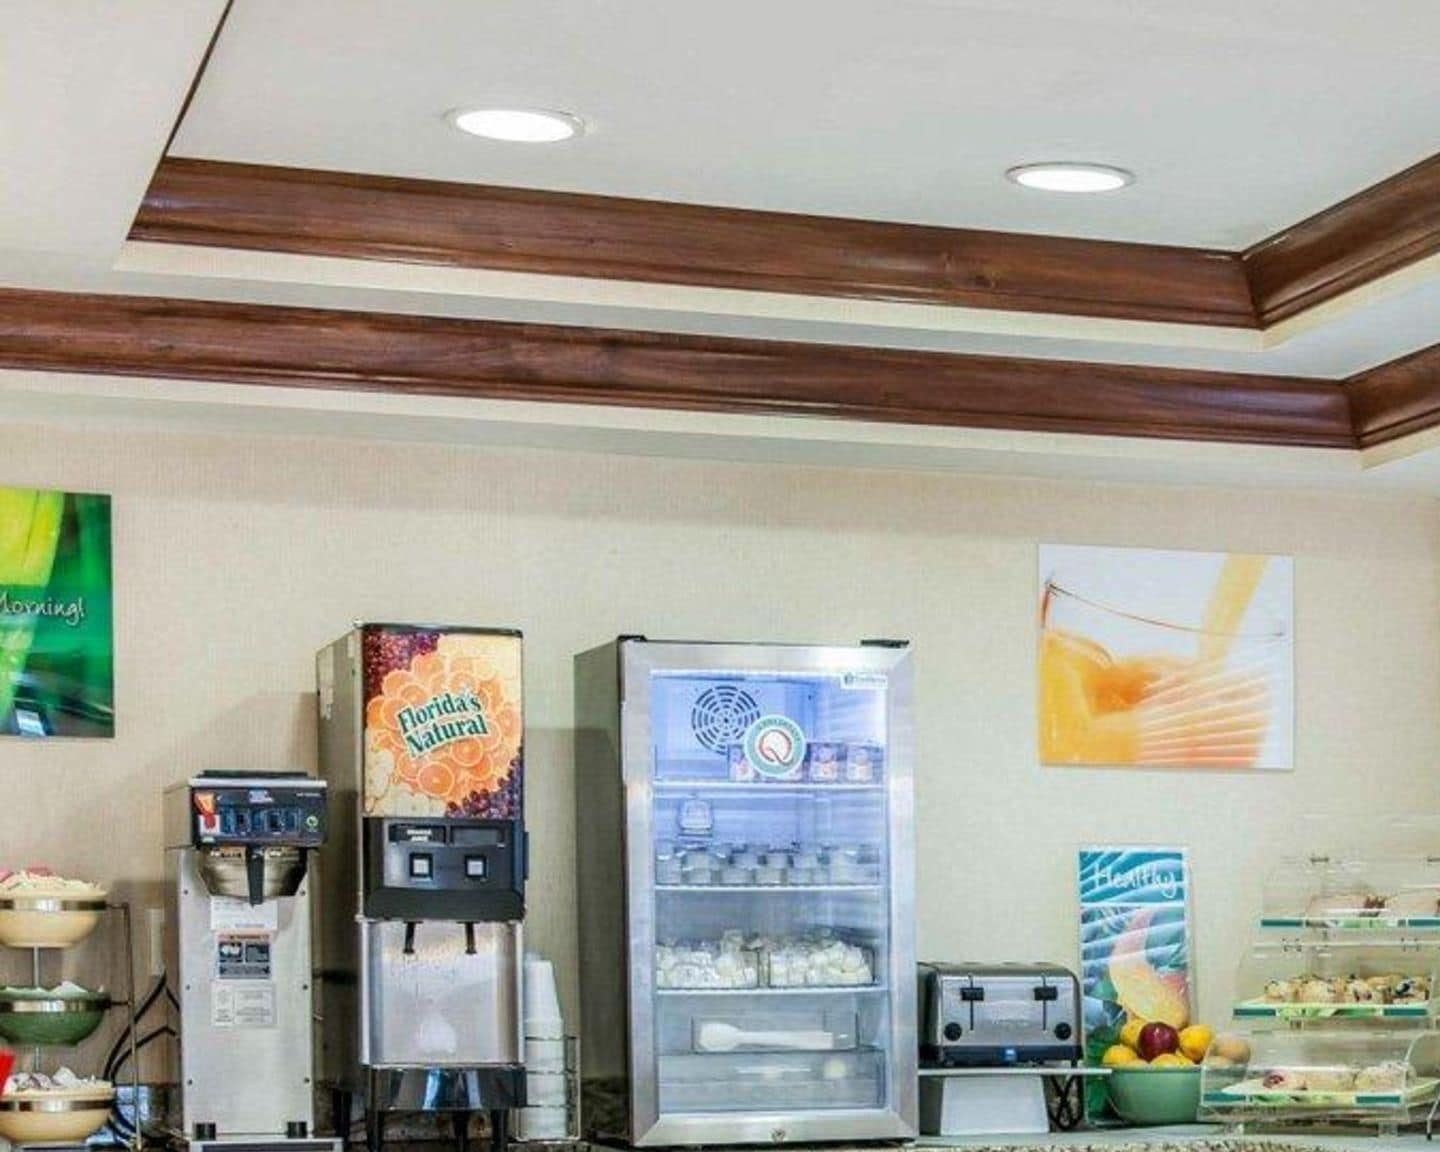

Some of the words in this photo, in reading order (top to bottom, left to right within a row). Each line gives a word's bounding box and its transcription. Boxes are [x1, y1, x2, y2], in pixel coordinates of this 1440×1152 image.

[397, 689, 482, 733] Florida's
[406, 714, 488, 757] Natural
[1093, 863, 1177, 899] Healthy
